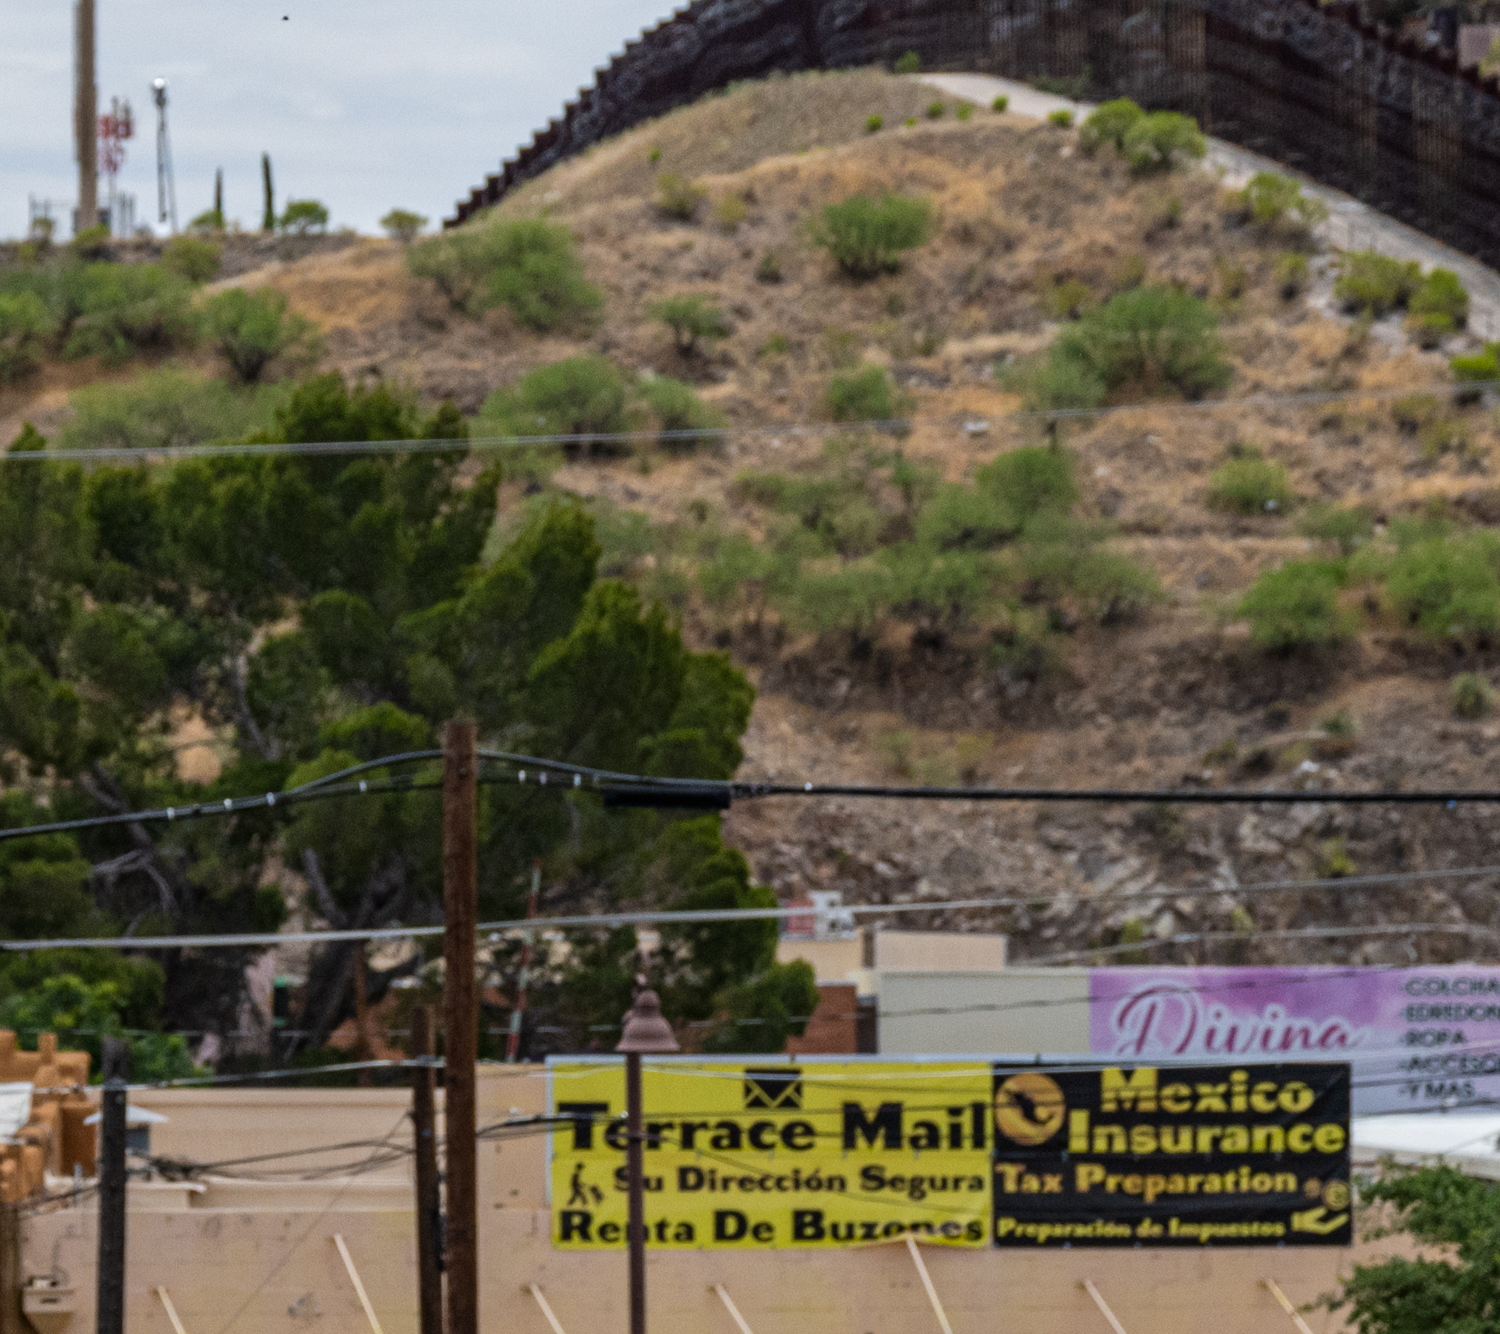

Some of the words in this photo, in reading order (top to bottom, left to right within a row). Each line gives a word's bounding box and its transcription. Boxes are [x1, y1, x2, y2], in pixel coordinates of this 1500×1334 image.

[1116, 981, 1352, 1055] Divina
[1405, 1029, 1467, 1048] ROPA
[1101, 1067, 1315, 1114] Mexico
[557, 1101, 816, 1151] Terrace
[841, 1101, 988, 1151] Mail
[1068, 1109, 1346, 1154] Insurance
[677, 1165, 847, 1193] Dirección
[860, 1165, 985, 1201] Segura
[997, 1163, 1063, 1195] Tax
[1075, 1162, 1298, 1204] Preparation
[713, 1210, 776, 1244] De
[793, 1209, 984, 1244] Buzones
[1168, 1218, 1287, 1244] Impuestos
